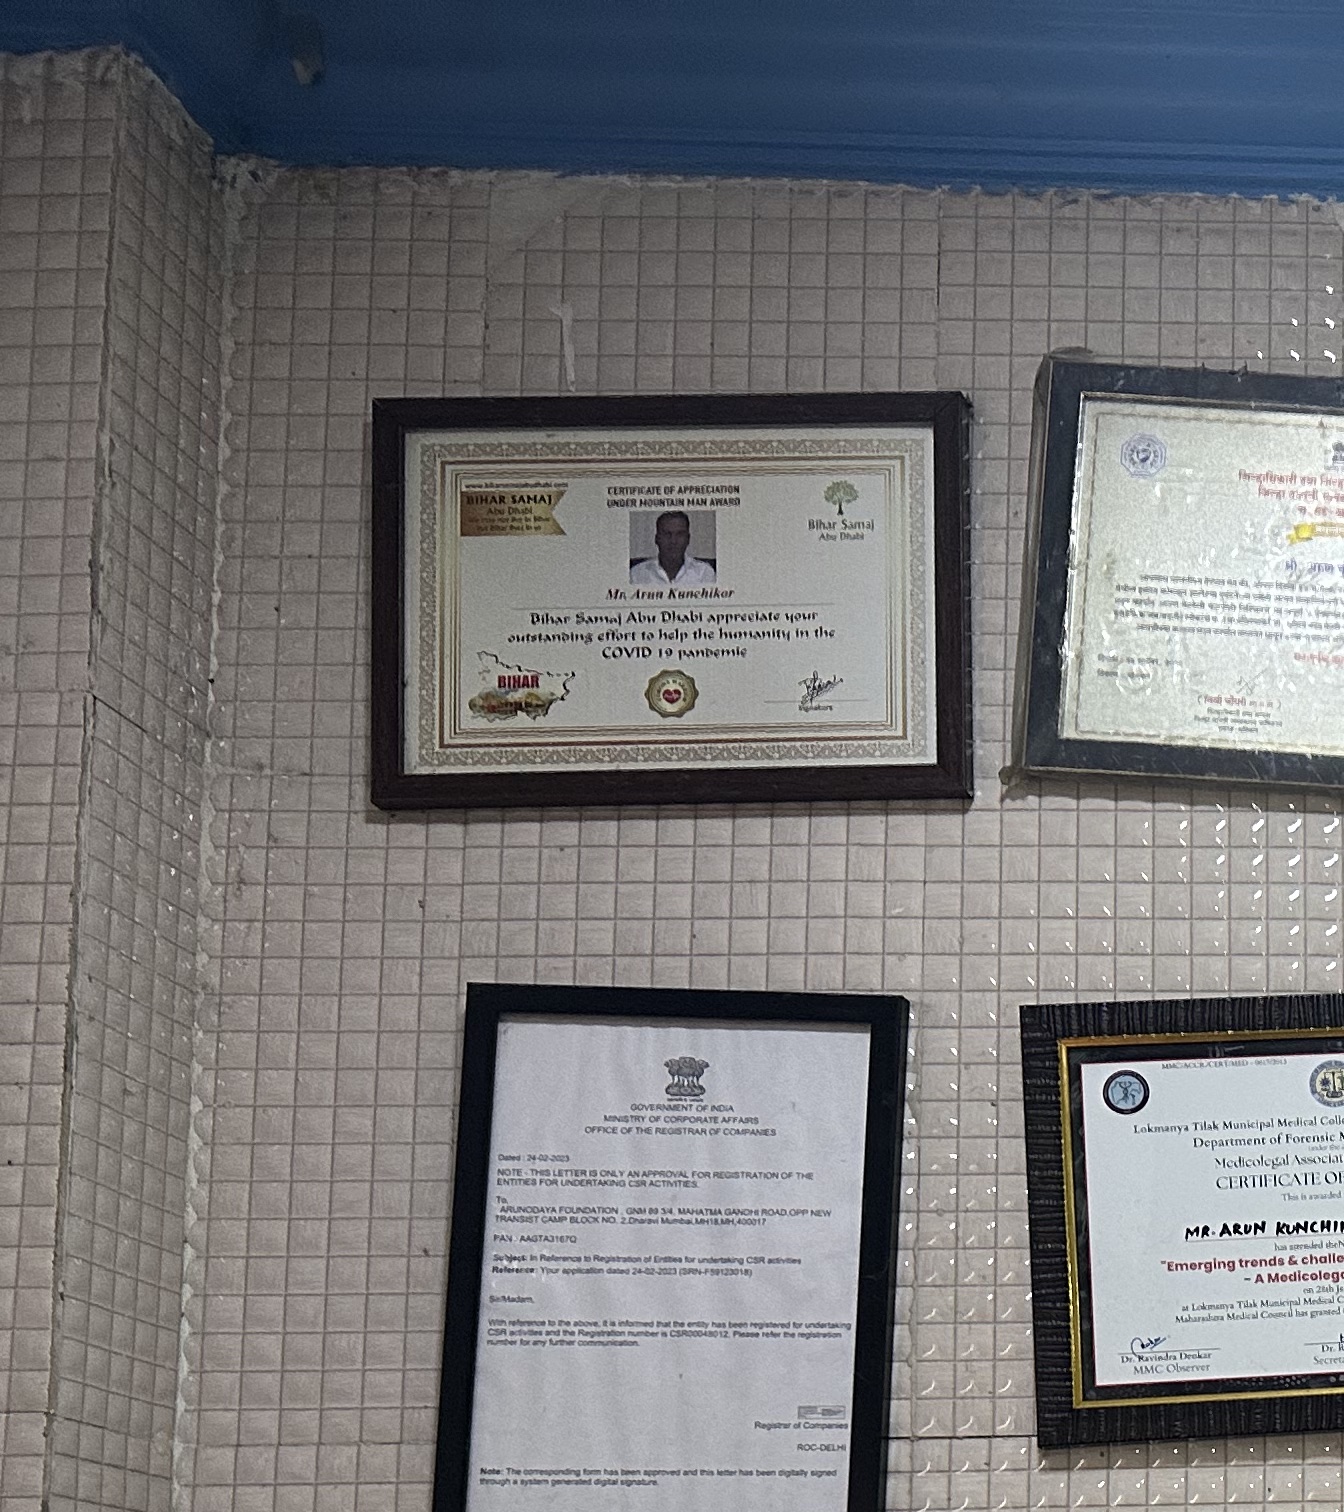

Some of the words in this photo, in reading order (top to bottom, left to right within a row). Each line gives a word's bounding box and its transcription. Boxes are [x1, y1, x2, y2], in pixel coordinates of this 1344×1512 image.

[530, 612, 570, 624] Bihar
[576, 612, 621, 626] Samaj
[626, 612, 656, 623] Abu
[662, 611, 702, 623] Dhabi
[707, 612, 780, 625] appreciate
[785, 612, 818, 623] your
[602, 647, 651, 659] COVID
[658, 648, 673, 658] 19
[678, 647, 747, 660] pandemic
[498, 674, 540, 689] BIHAR
[631, 1104, 693, 1112] GOVERNMENT
[696, 1104, 708, 1112] OF
[711, 1105, 734, 1113] INDIA
[604, 1115, 646, 1123] MINISTRY
[649, 1116, 661, 1124] OF
[663, 1116, 718, 1124] CORPORATE
[721, 1116, 759, 1125] AFFAIRS
[585, 1126, 618, 1134] OFFICE
[621, 1127, 633, 1135] OF
[636, 1127, 652, 1135] THE
[655, 1127, 706, 1136] REGISTRAR
[708, 1128, 721, 1136] OF
[723, 1128, 776, 1137] COMPANIES
[1193, 1134, 1266, 1150] Department
[1269, 1132, 1283, 1145] of
[1286, 1130, 1336, 1144] Forensic
[1215, 1154, 1289, 1172] Medicolegal
[1216, 1171, 1321, 1191] CERTIFICATE
[1185, 1226, 1216, 1242] MR.
[1219, 1220, 1266, 1237] ARUN
[1238, 1256, 1285, 1270] trends
[1288, 1255, 1299, 1266] &
[1254, 1272, 1266, 1284] A
